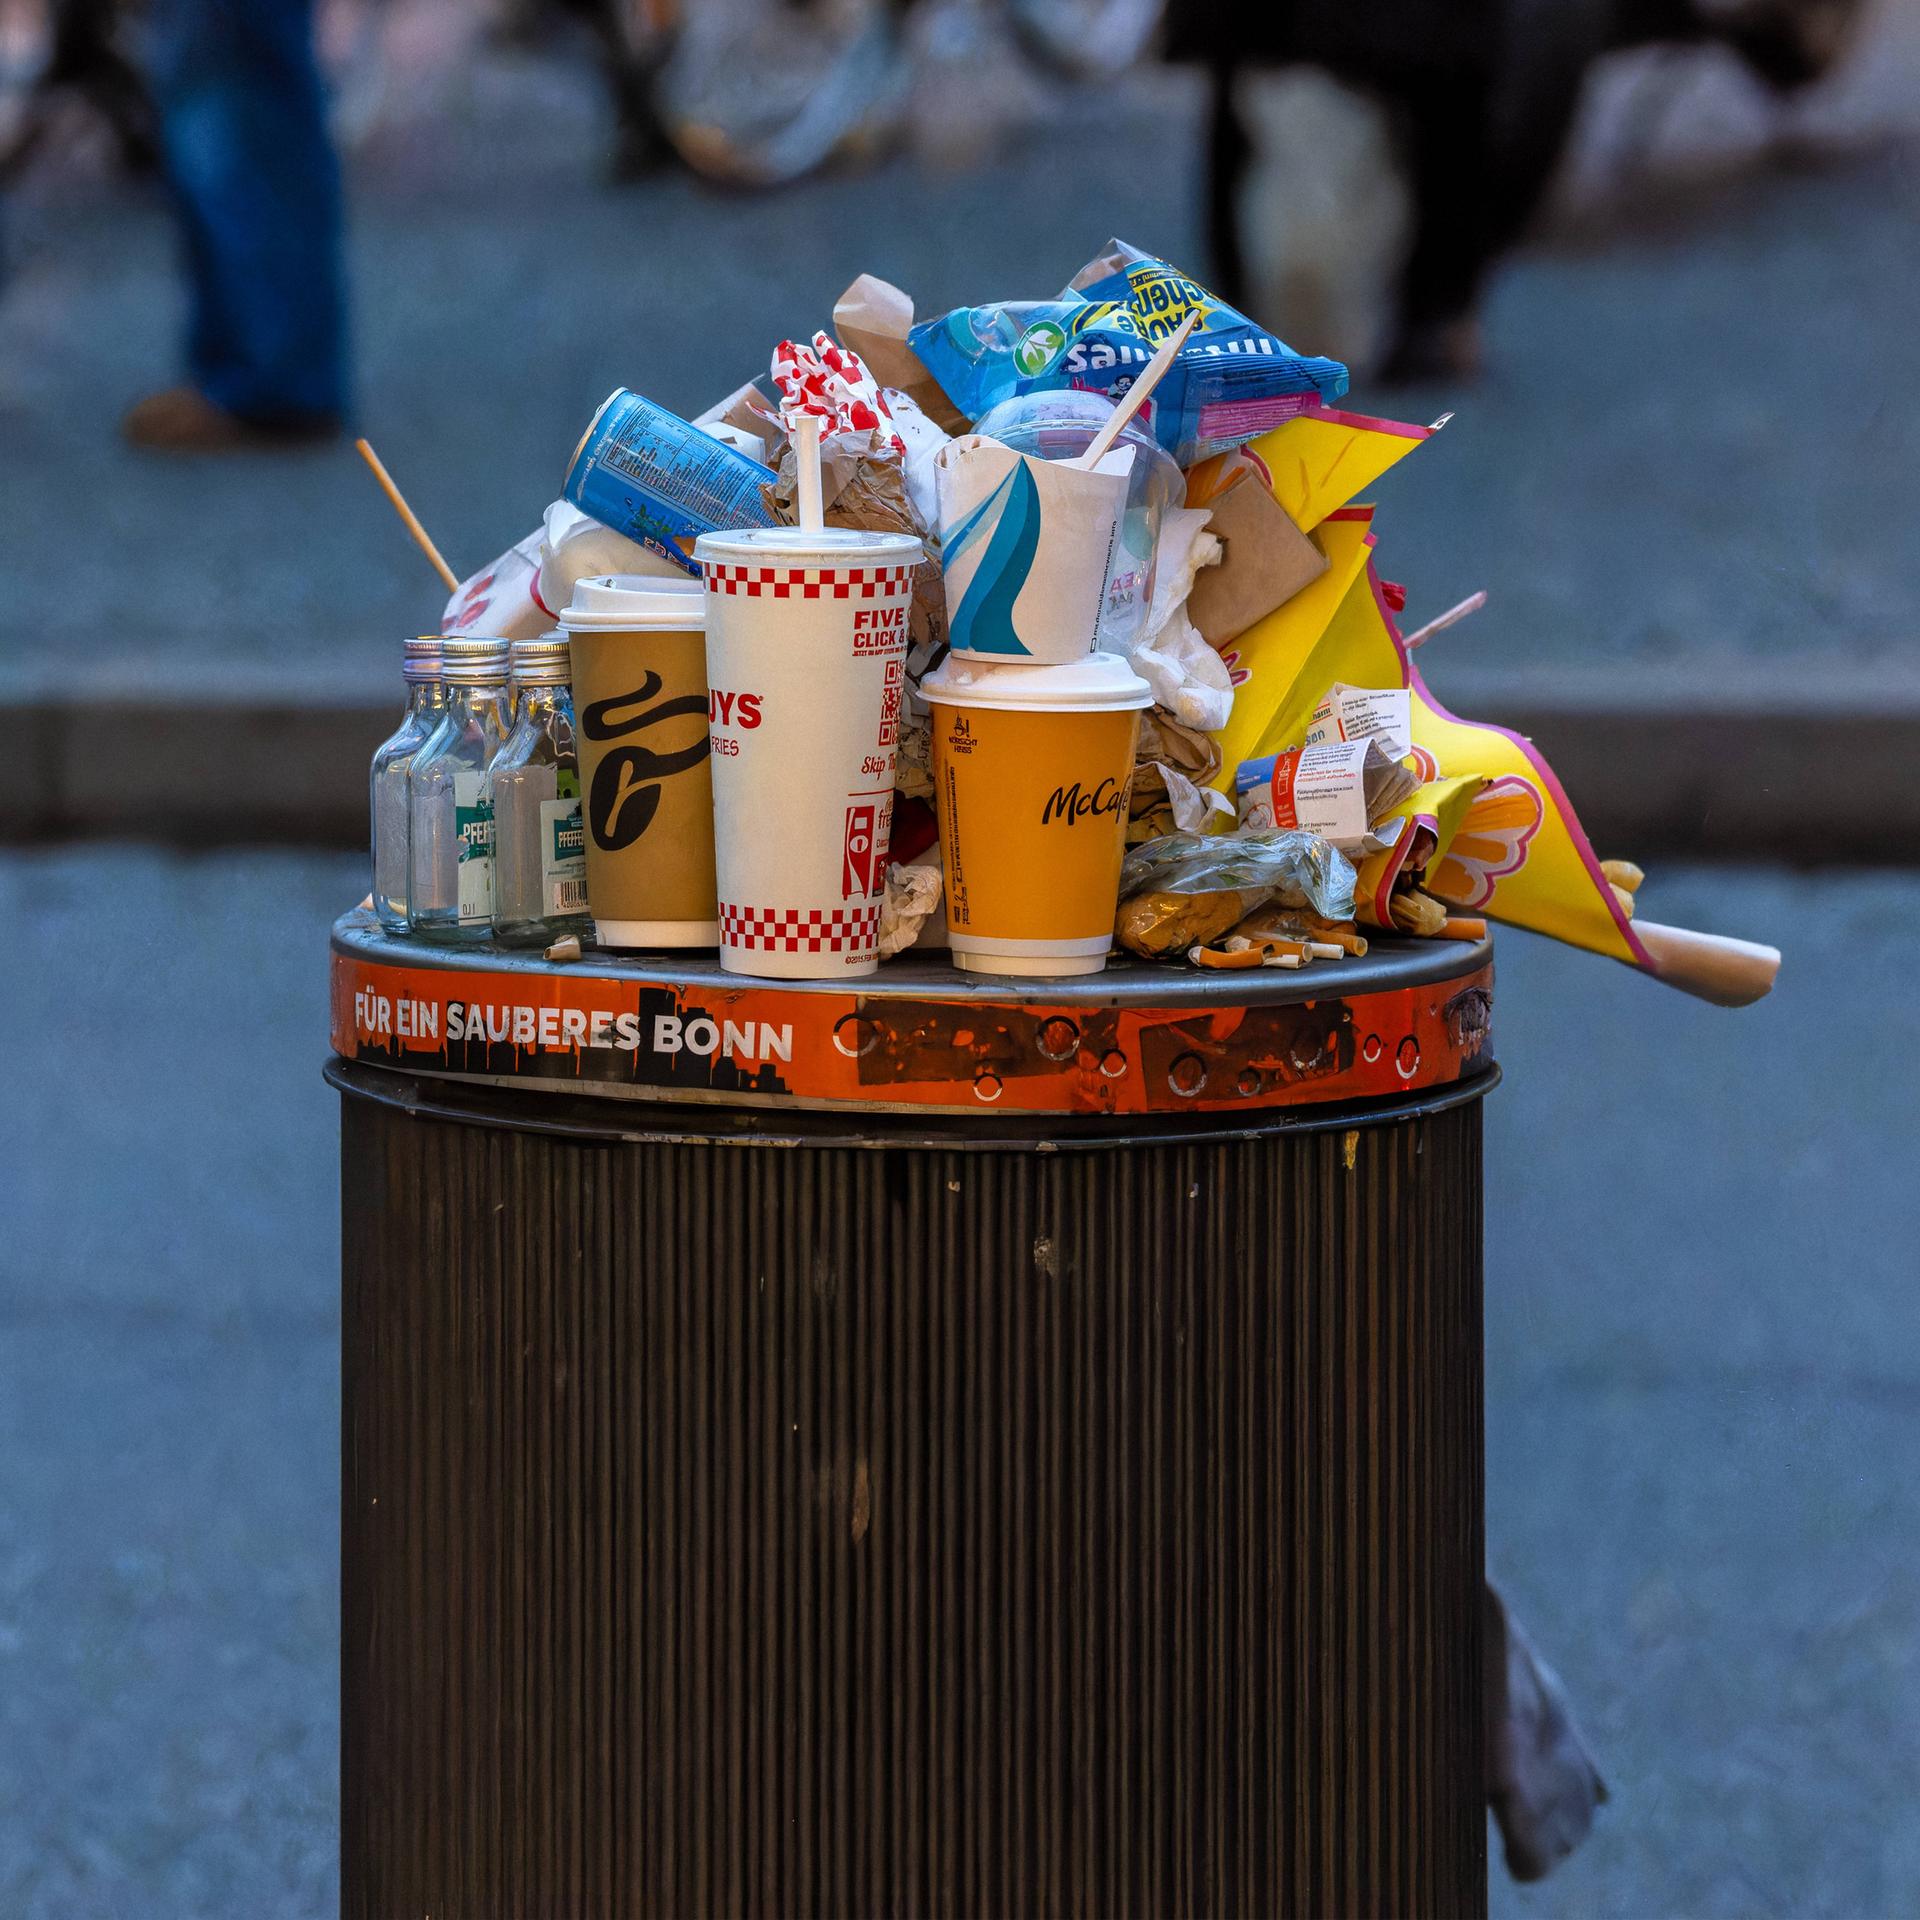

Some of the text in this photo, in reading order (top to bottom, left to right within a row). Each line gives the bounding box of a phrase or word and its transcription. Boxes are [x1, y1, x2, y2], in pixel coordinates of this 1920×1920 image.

[853, 607, 905, 629] FIVE
[853, 628, 905, 648] CLICK &
[861, 756, 886, 781] Skip
[355, 984, 793, 1062] FÜR EIN SAUBERES BONN
